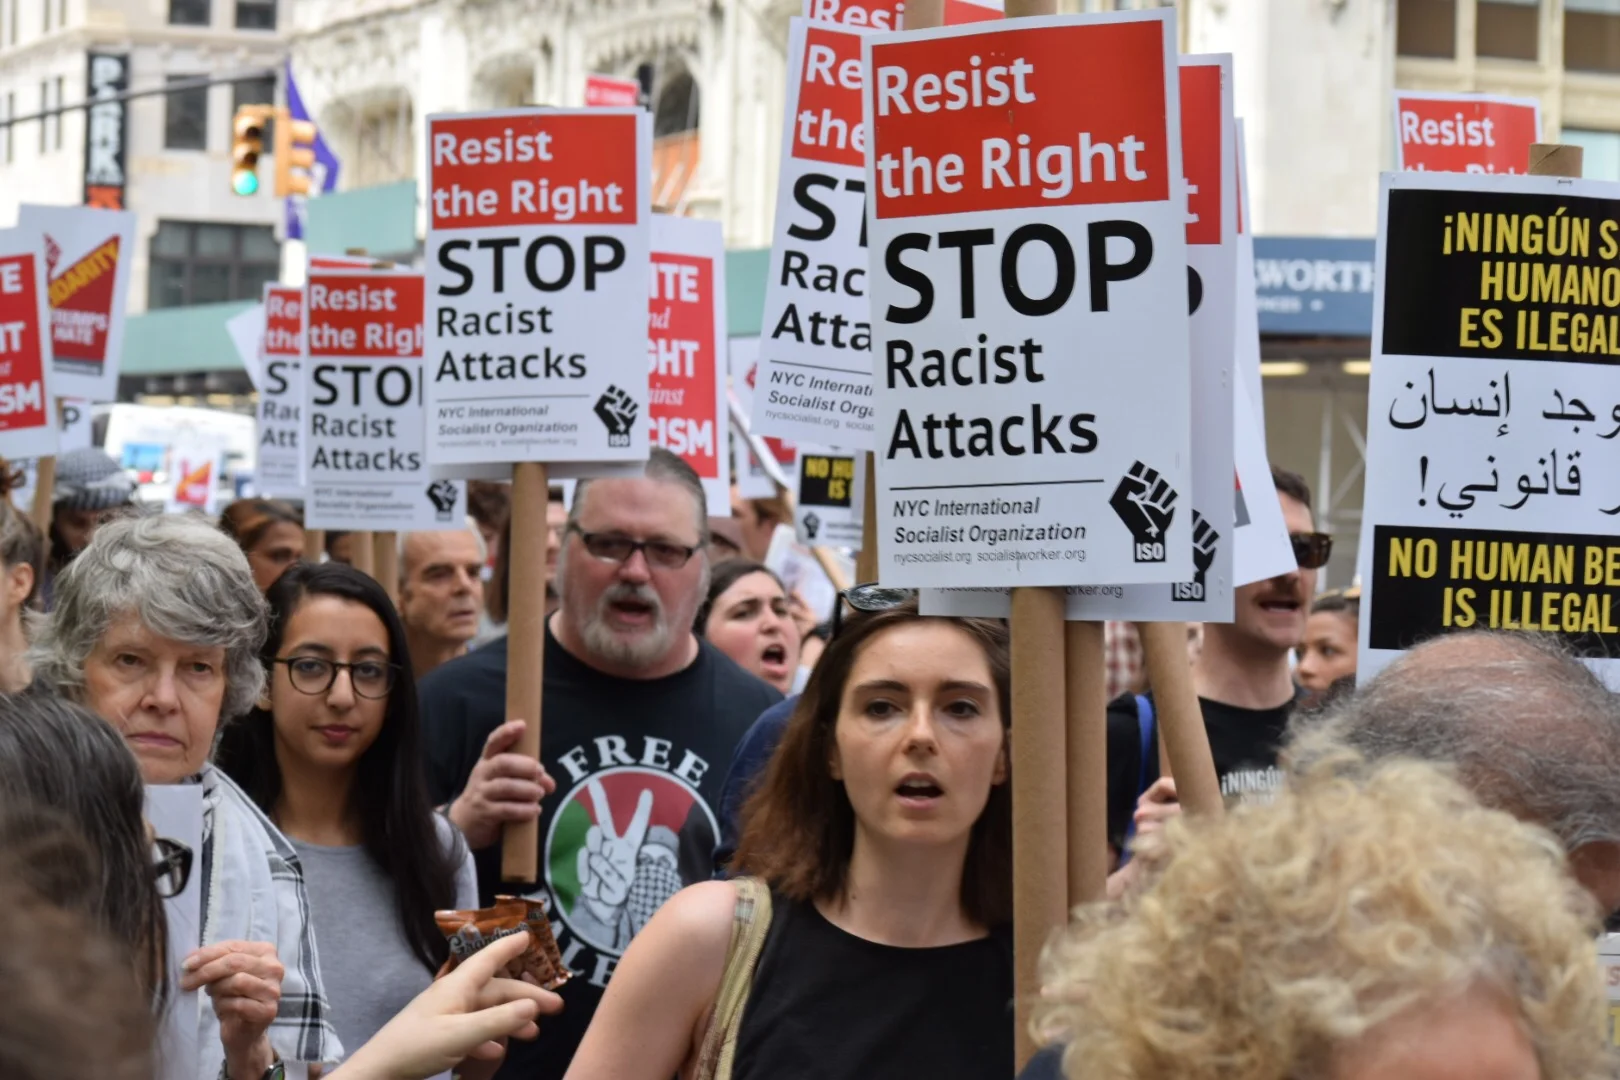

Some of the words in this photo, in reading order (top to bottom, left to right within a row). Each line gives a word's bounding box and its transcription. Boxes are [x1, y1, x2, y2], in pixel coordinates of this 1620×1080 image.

[877, 55, 1036, 117] Resist
[433, 128, 554, 167] Resist
[1401, 110, 1496, 147] Resist
[876, 146, 965, 199] the
[981, 132, 1148, 200] Right
[433, 184, 498, 219] the
[511, 178, 624, 222] Right
[1443, 206, 1590, 258] ¡NINGÚN
[437, 235, 626, 297] STOP
[884, 219, 1154, 325] STOP
[1480, 261, 1620, 308] HUMANO
[310, 284, 397, 312] Resist
[309, 321, 357, 350] the
[437, 302, 554, 337] Racist
[1459, 307, 1503, 349] ES
[435, 347, 587, 382] Attacks
[770, 370, 806, 388] NYC
[886, 333, 1046, 389] Racist
[312, 364, 423, 408] STO
[768, 389, 837, 413] Socialist
[1388, 366, 1512, 438] إنسان
[312, 413, 396, 438] Racist
[609, 434, 630, 447] ISO
[886, 403, 1099, 461] Attacks
[311, 445, 421, 471] Attacks
[893, 500, 929, 518] NYC
[933, 497, 1041, 517] International
[893, 525, 965, 544] Socialist
[968, 522, 1087, 547] Organization
[1136, 542, 1164, 561] ISO
[893, 551, 972, 566] nycsocialist.org
[976, 548, 1087, 563] socialistworker.org
[1388, 537, 1439, 579] NO
[1449, 540, 1575, 586] HUMAN
[1173, 582, 1203, 600] ISO
[1442, 587, 1477, 629] IS
[1488, 589, 1619, 634] ILLEGAL
[557, 735, 711, 789] FREE
